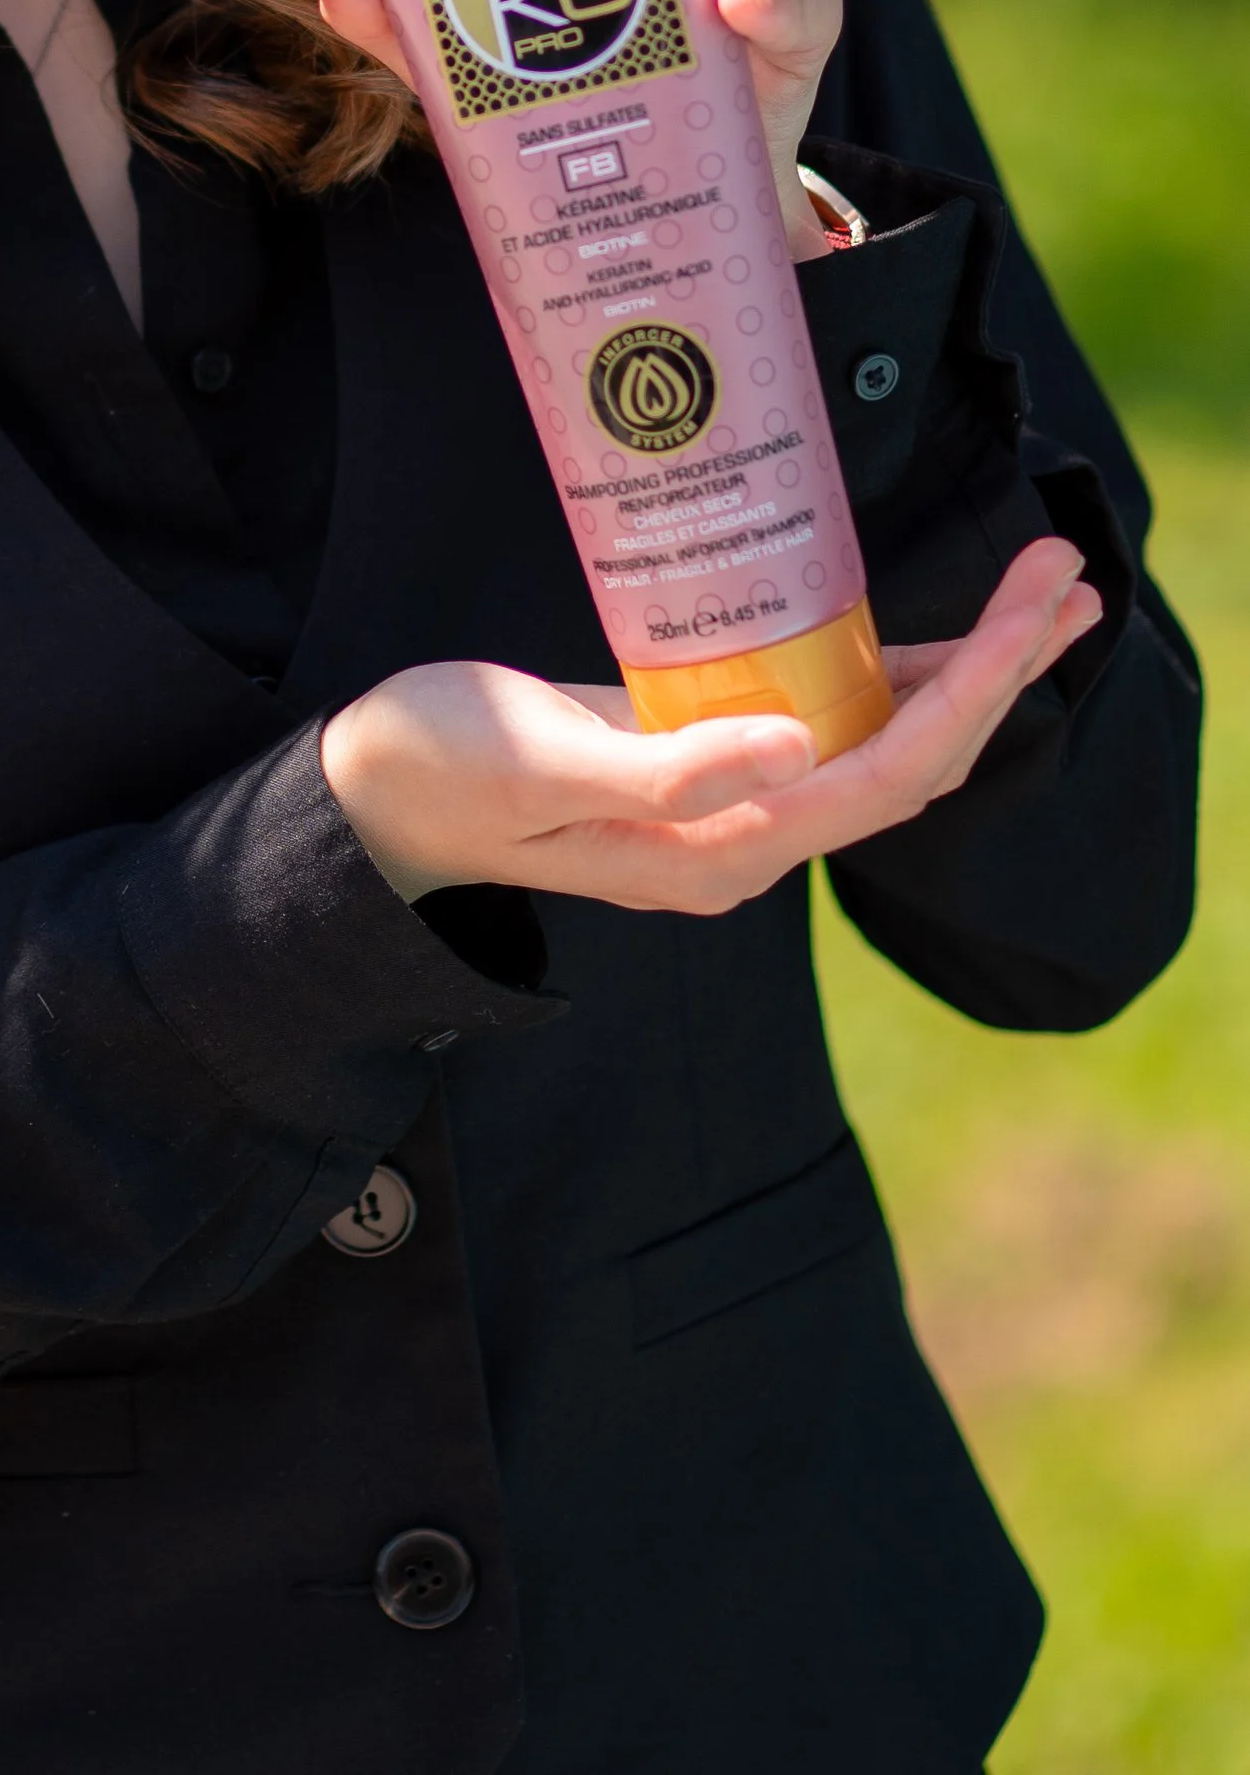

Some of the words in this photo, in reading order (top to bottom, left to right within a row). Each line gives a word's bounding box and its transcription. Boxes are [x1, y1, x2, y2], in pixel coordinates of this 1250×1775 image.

[513, 26, 585, 60] PRO
[516, 123, 564, 148] SANS
[565, 102, 647, 133] SULFATES
[566, 151, 619, 183] FB
[501, 236, 519, 254] ET
[523, 225, 574, 250] ACIDE
[576, 185, 723, 236] HYALURONIQUE
[577, 230, 649, 260] BIOTINE
[542, 293, 573, 312] AND
[574, 269, 674, 304] HYALURONIC
[675, 259, 713, 278] ACID
[586, 257, 653, 284] KERATIN
[603, 296, 656, 318] BIOTIN
[599, 328, 685, 366] INFORCER
[631, 420, 698, 448] SYSTEM
[564, 472, 660, 500] SHAMPOOING
[664, 429, 805, 485] PROFESSIONNEL
[618, 472, 748, 515] RENFORCATEUR
[633, 506, 702, 531] CHEVEUX
[702, 492, 743, 515] SECS
[593, 553, 672, 573] PROFESSIONAL
[677, 532, 749, 562] INFORCER
[751, 508, 817, 543] SHAMPOO
[613, 524, 676, 553] FRAGILES
[678, 524, 695, 542] ET
[699, 501, 777, 536] CASSANTS
[603, 575, 623, 590] DRY
[624, 574, 651, 588] HAIR
[660, 559, 714, 582] FRAGILE
[731, 538, 785, 566] BRITTLE
[785, 527, 815, 549] HAIR
[648, 619, 690, 641] 250ml
